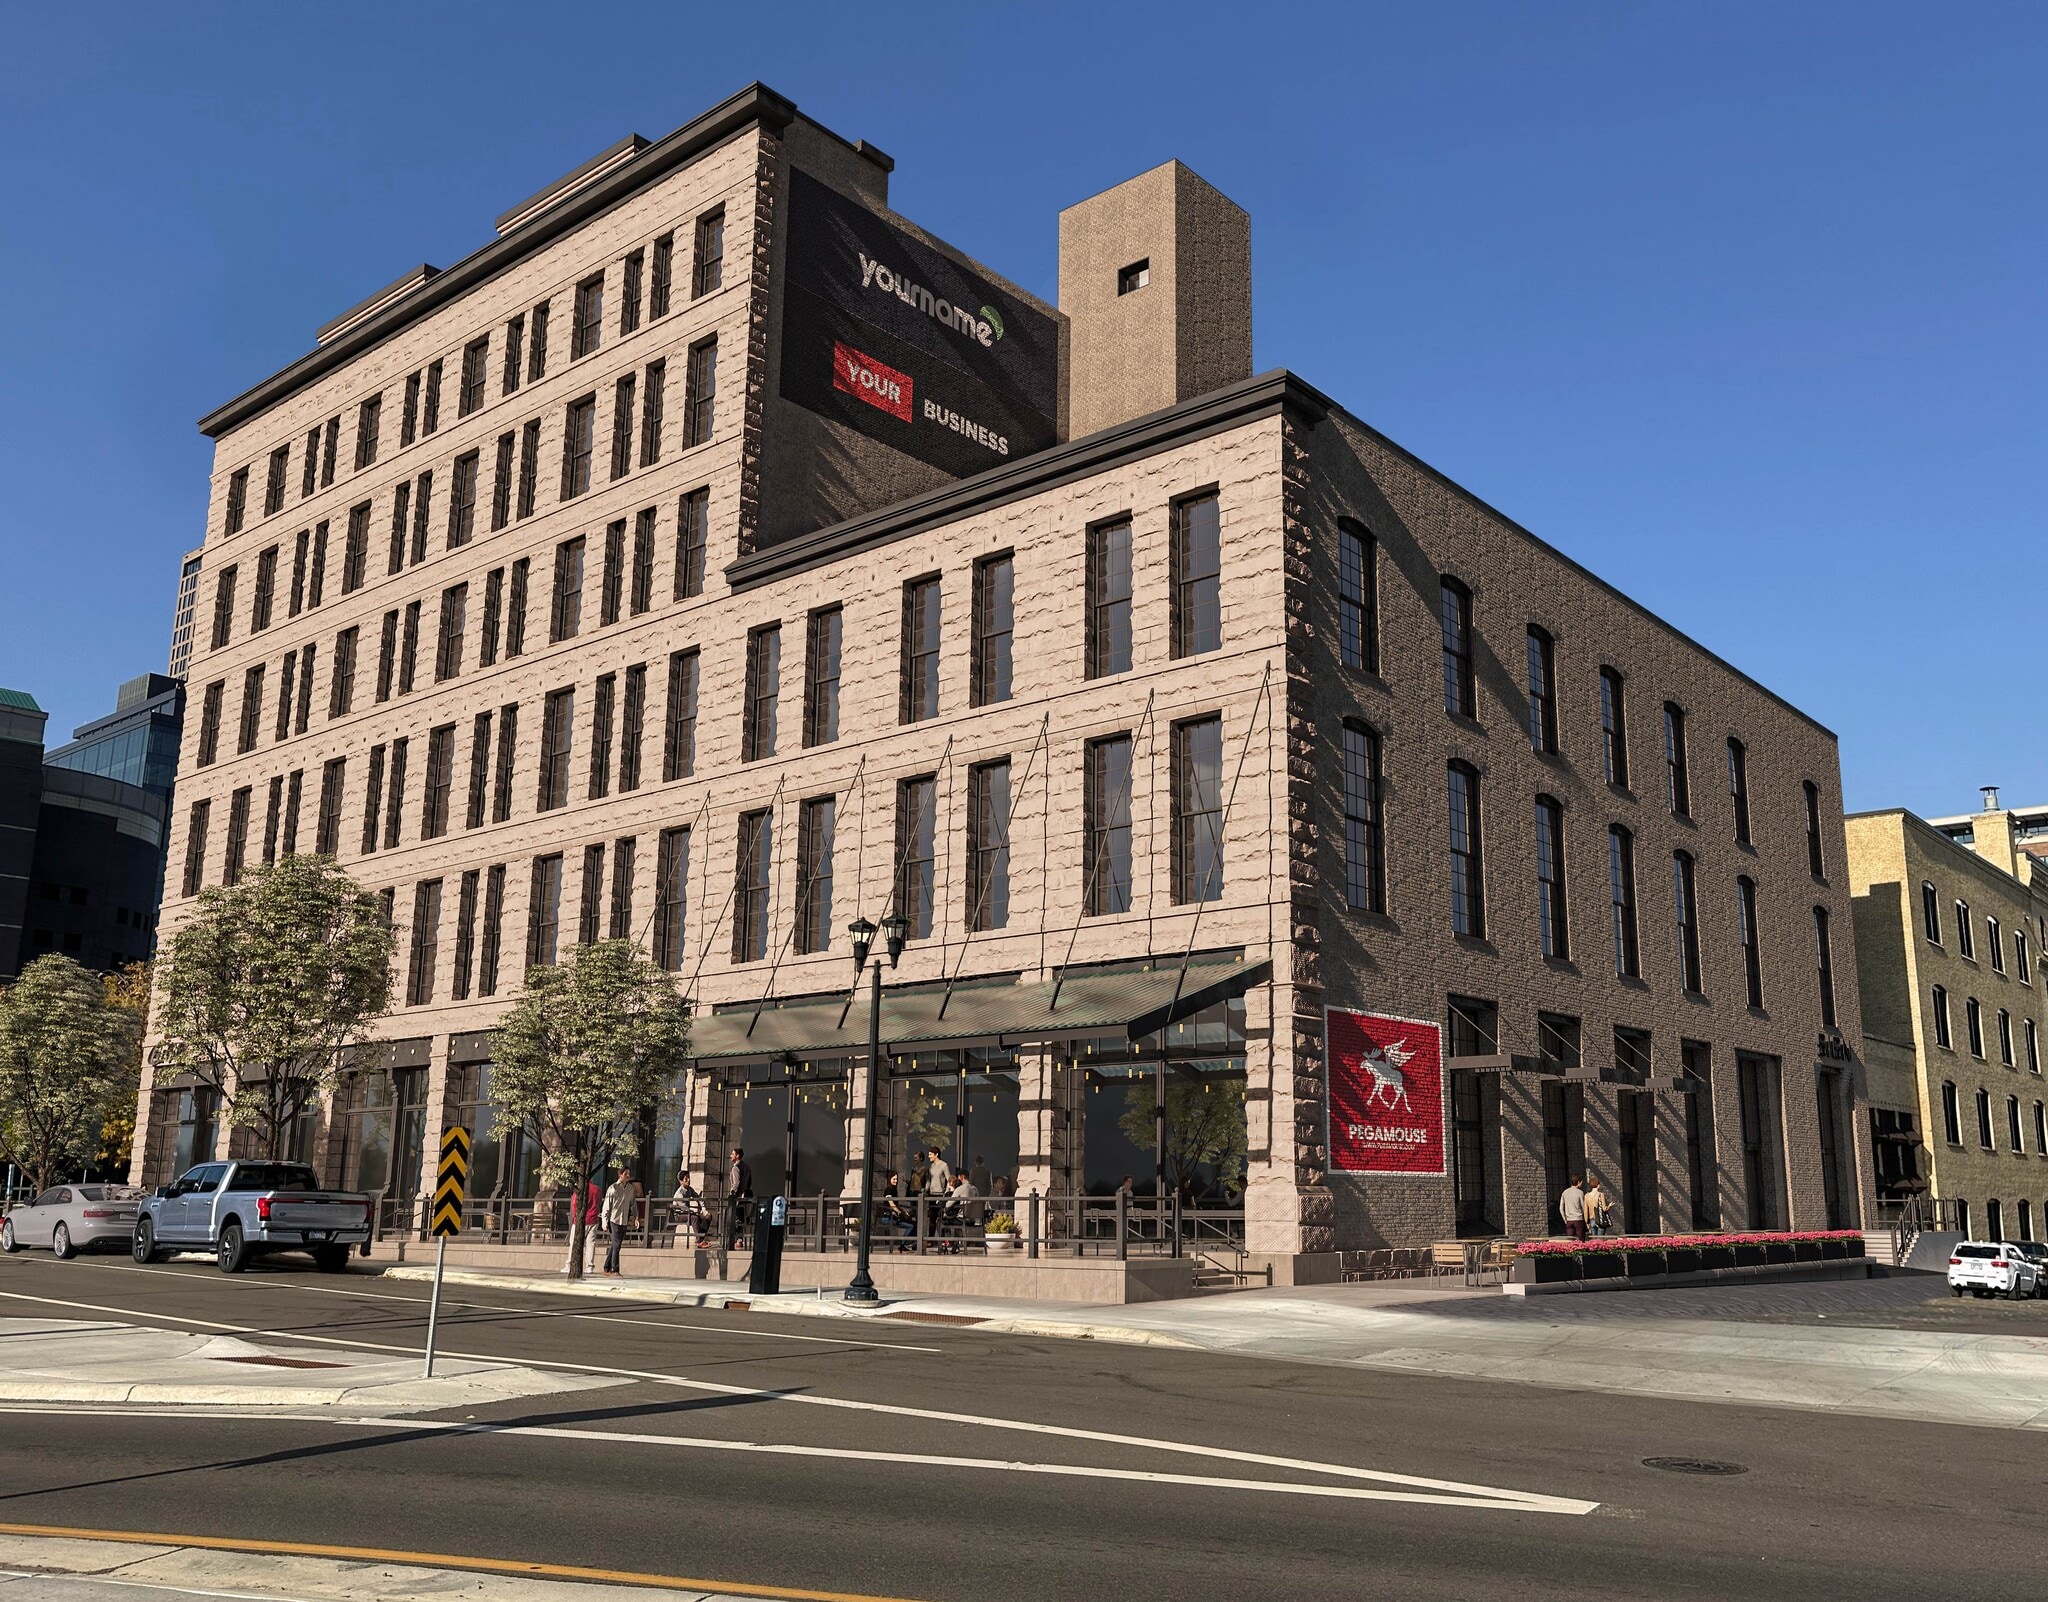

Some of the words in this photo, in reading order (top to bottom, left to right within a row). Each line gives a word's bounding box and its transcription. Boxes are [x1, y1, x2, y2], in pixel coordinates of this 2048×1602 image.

[859, 253, 993, 347] yourname
[846, 359, 901, 404] YOUR
[924, 399, 1009, 455] BUSINESS
[1349, 1124, 1428, 1143] PEGAMOUSE
